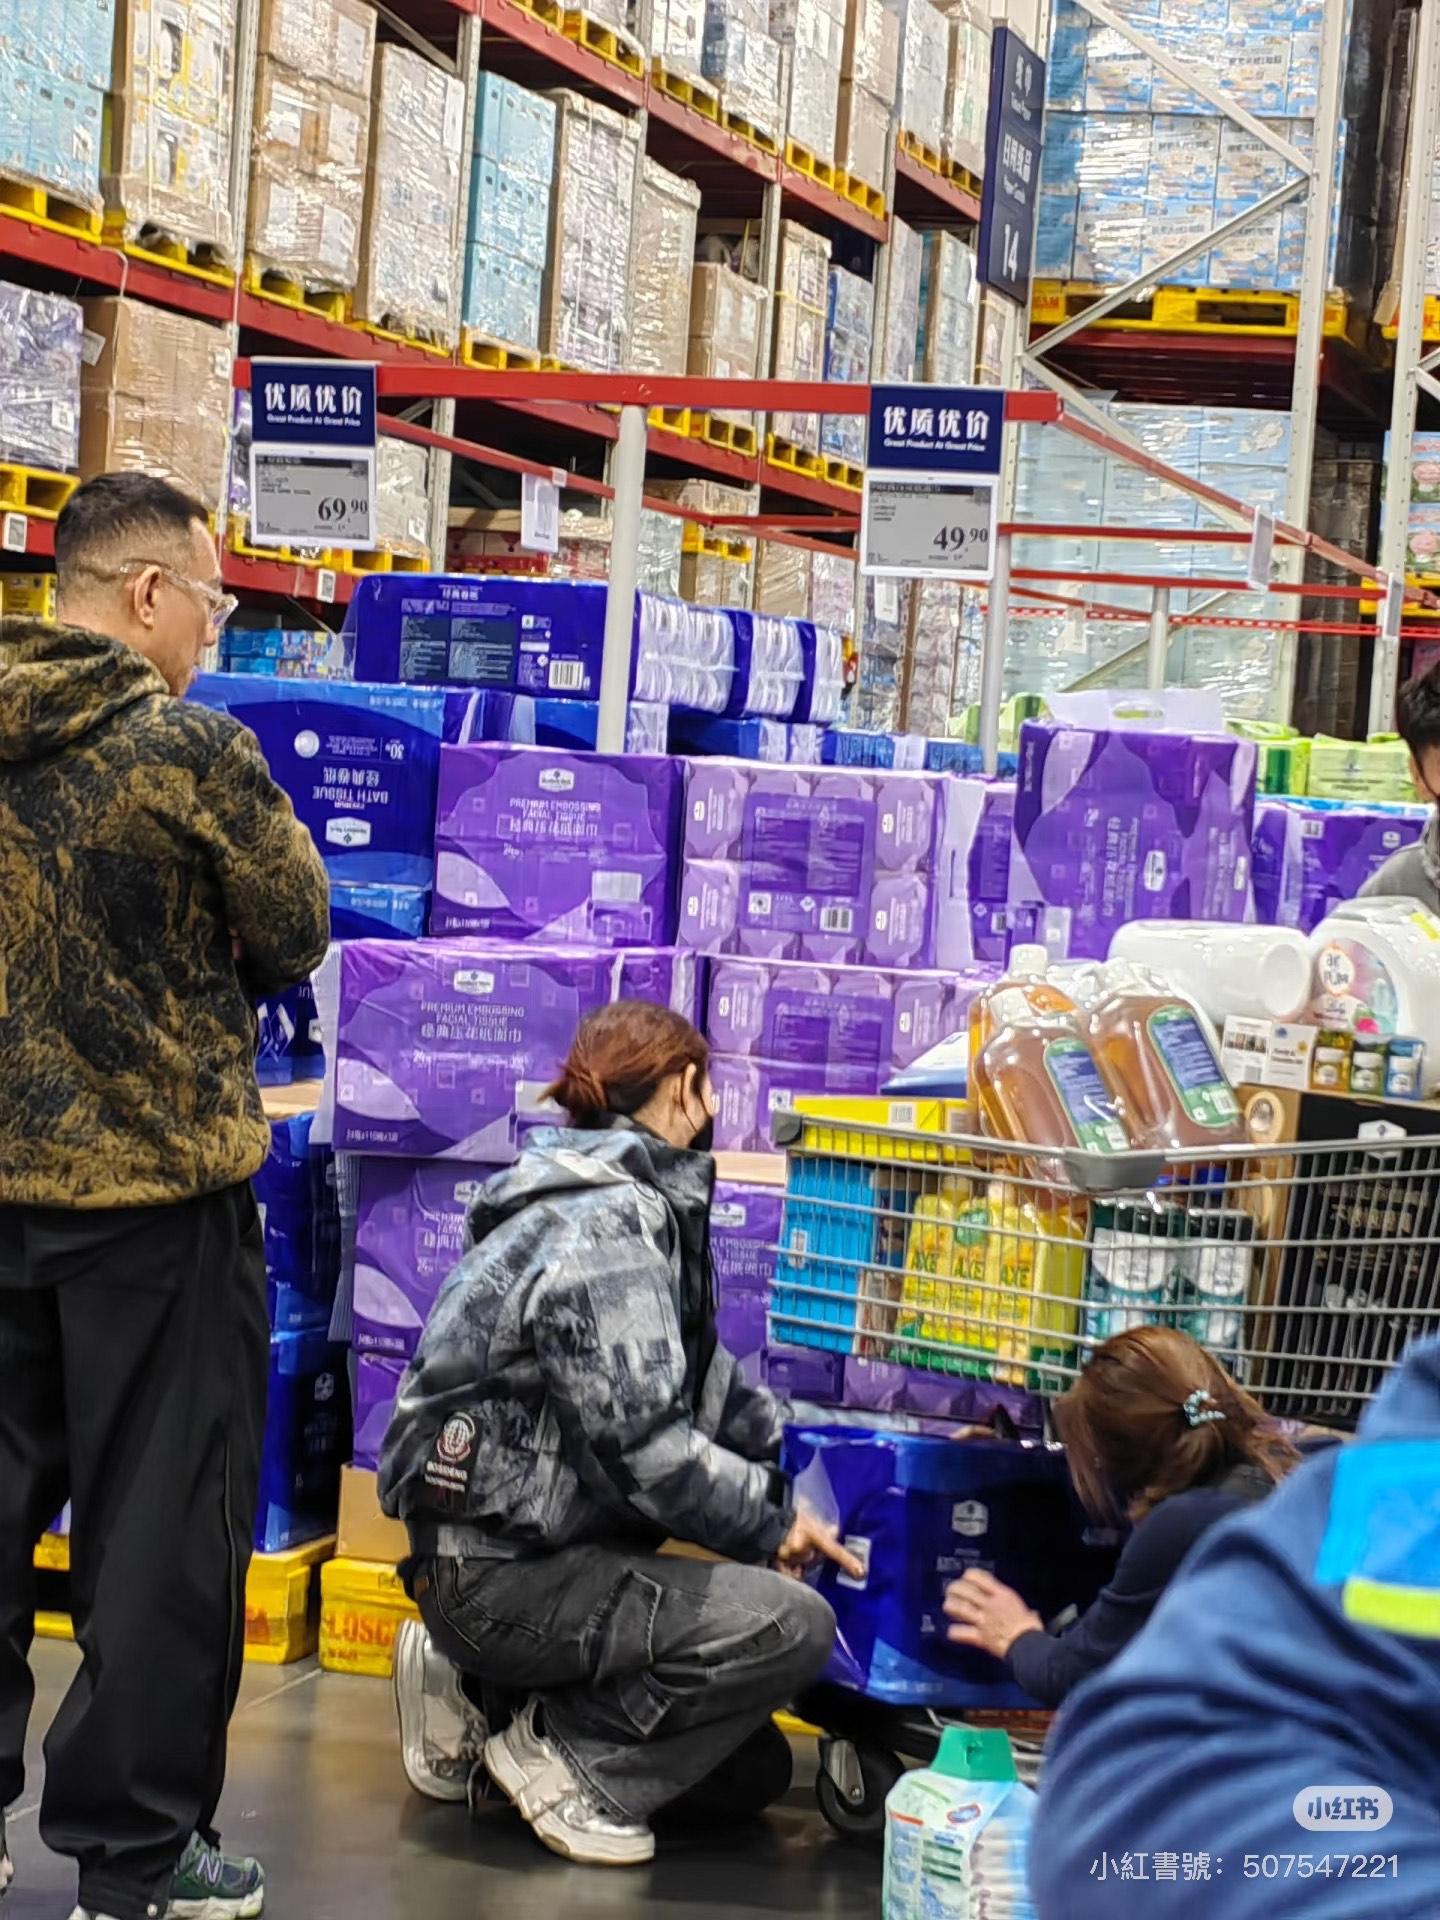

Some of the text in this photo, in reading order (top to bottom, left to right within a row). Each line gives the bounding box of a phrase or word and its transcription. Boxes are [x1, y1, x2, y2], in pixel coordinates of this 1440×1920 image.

[1002, 223, 1019, 282] 14
[264, 382, 363, 416] 优质优价
[883, 406, 990, 440] 优质优价
[312, 785, 389, 805] BATH TISSUE
[421, 1001, 465, 1014] PREMIUM
